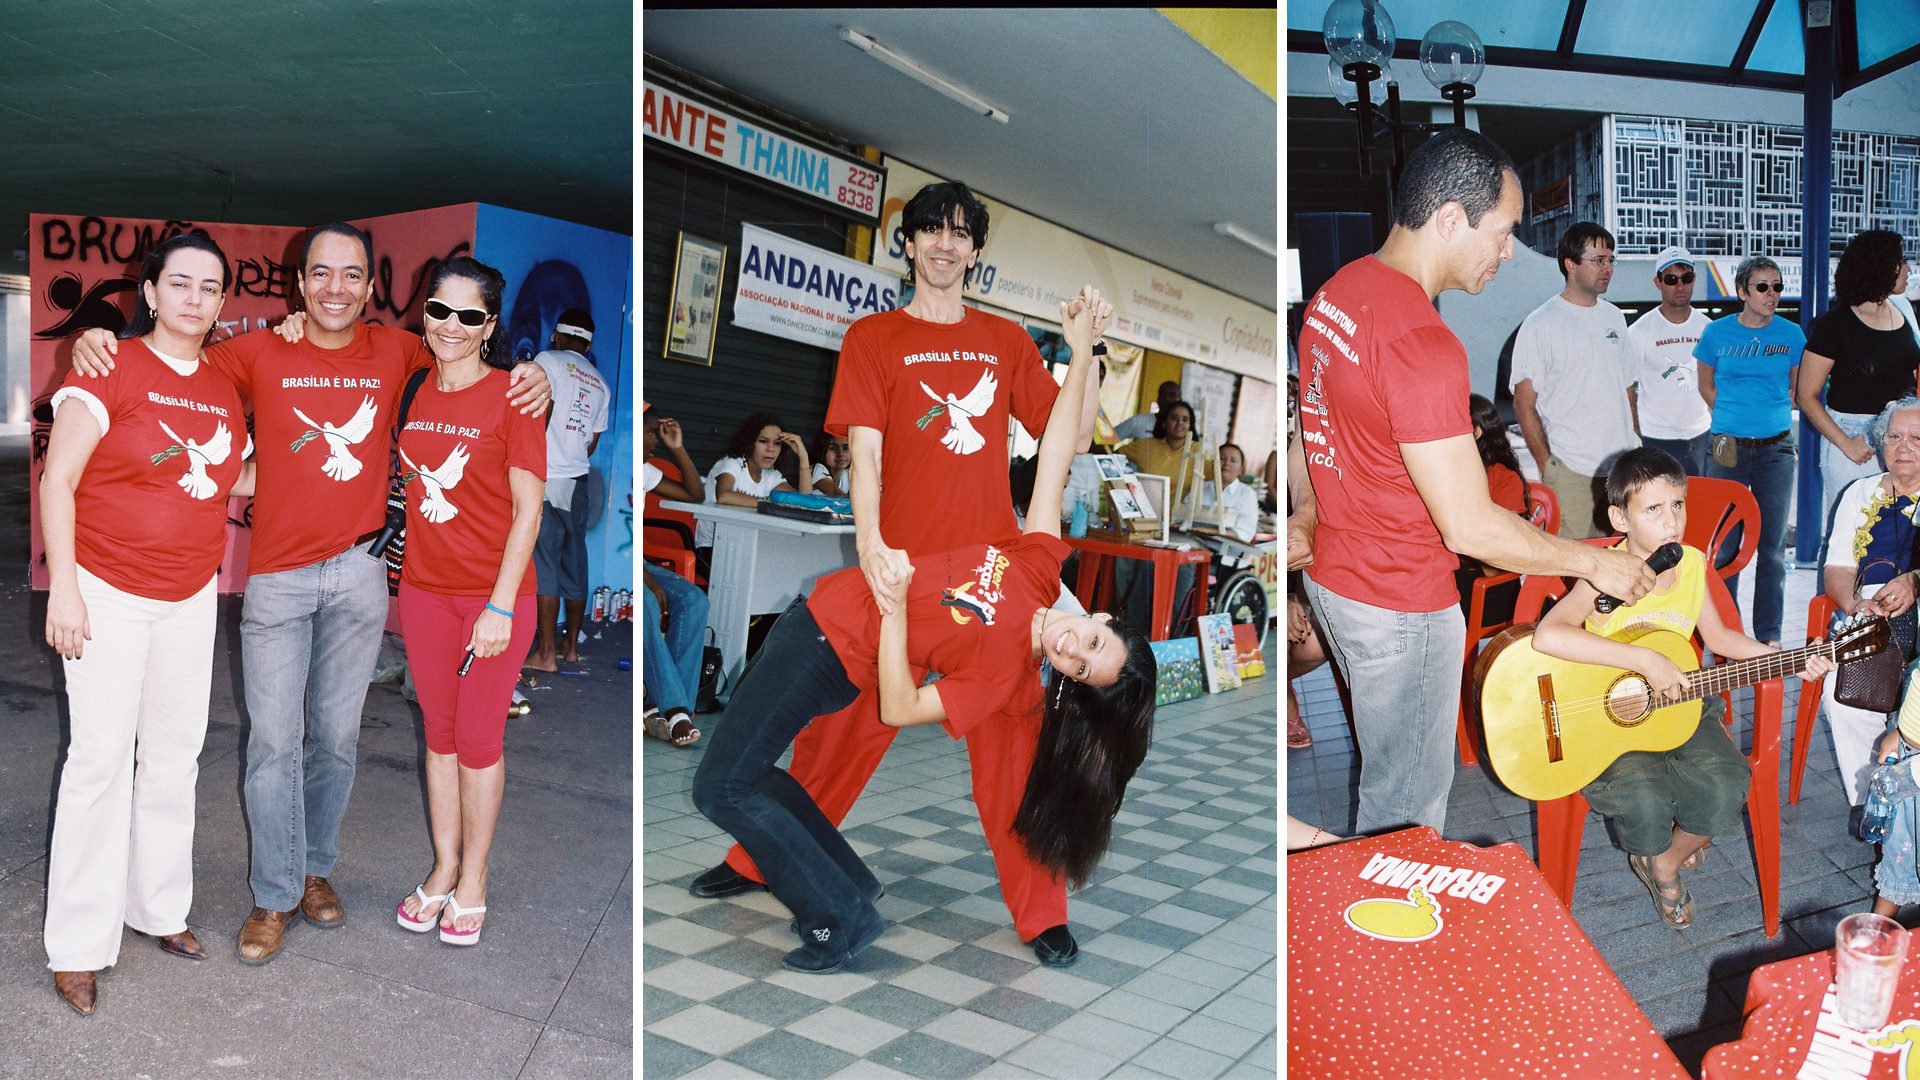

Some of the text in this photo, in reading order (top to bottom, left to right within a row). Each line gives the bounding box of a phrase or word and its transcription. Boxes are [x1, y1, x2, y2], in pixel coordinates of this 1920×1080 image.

[643, 87, 726, 158] ANTE
[837, 186, 873, 212] 8338
[43, 216, 210, 264] BRUN
[743, 244, 896, 313] ANDANÇAS
[740, 288, 788, 308] ASSOCIAÇÃO
[790, 302, 824, 318] NACIONAL
[825, 313, 834, 321] DE
[1317, 299, 1357, 338] MARATONA
[904, 349, 998, 366] BRASÍLIA É DA PAZ!
[282, 375, 380, 389] BRASÍLIA É DA PAZ!
[148, 391, 189, 409] BRASÍLIA
[196, 402, 210, 413] DA
[209, 405, 229, 418] PAZ!
[444, 424, 456, 435] DA
[457, 426, 480, 439] PAZ!
[992, 555, 1010, 590] Quer
[1664, 611, 1692, 632] BEACH
[1358, 852, 1506, 905] BRAHMA
